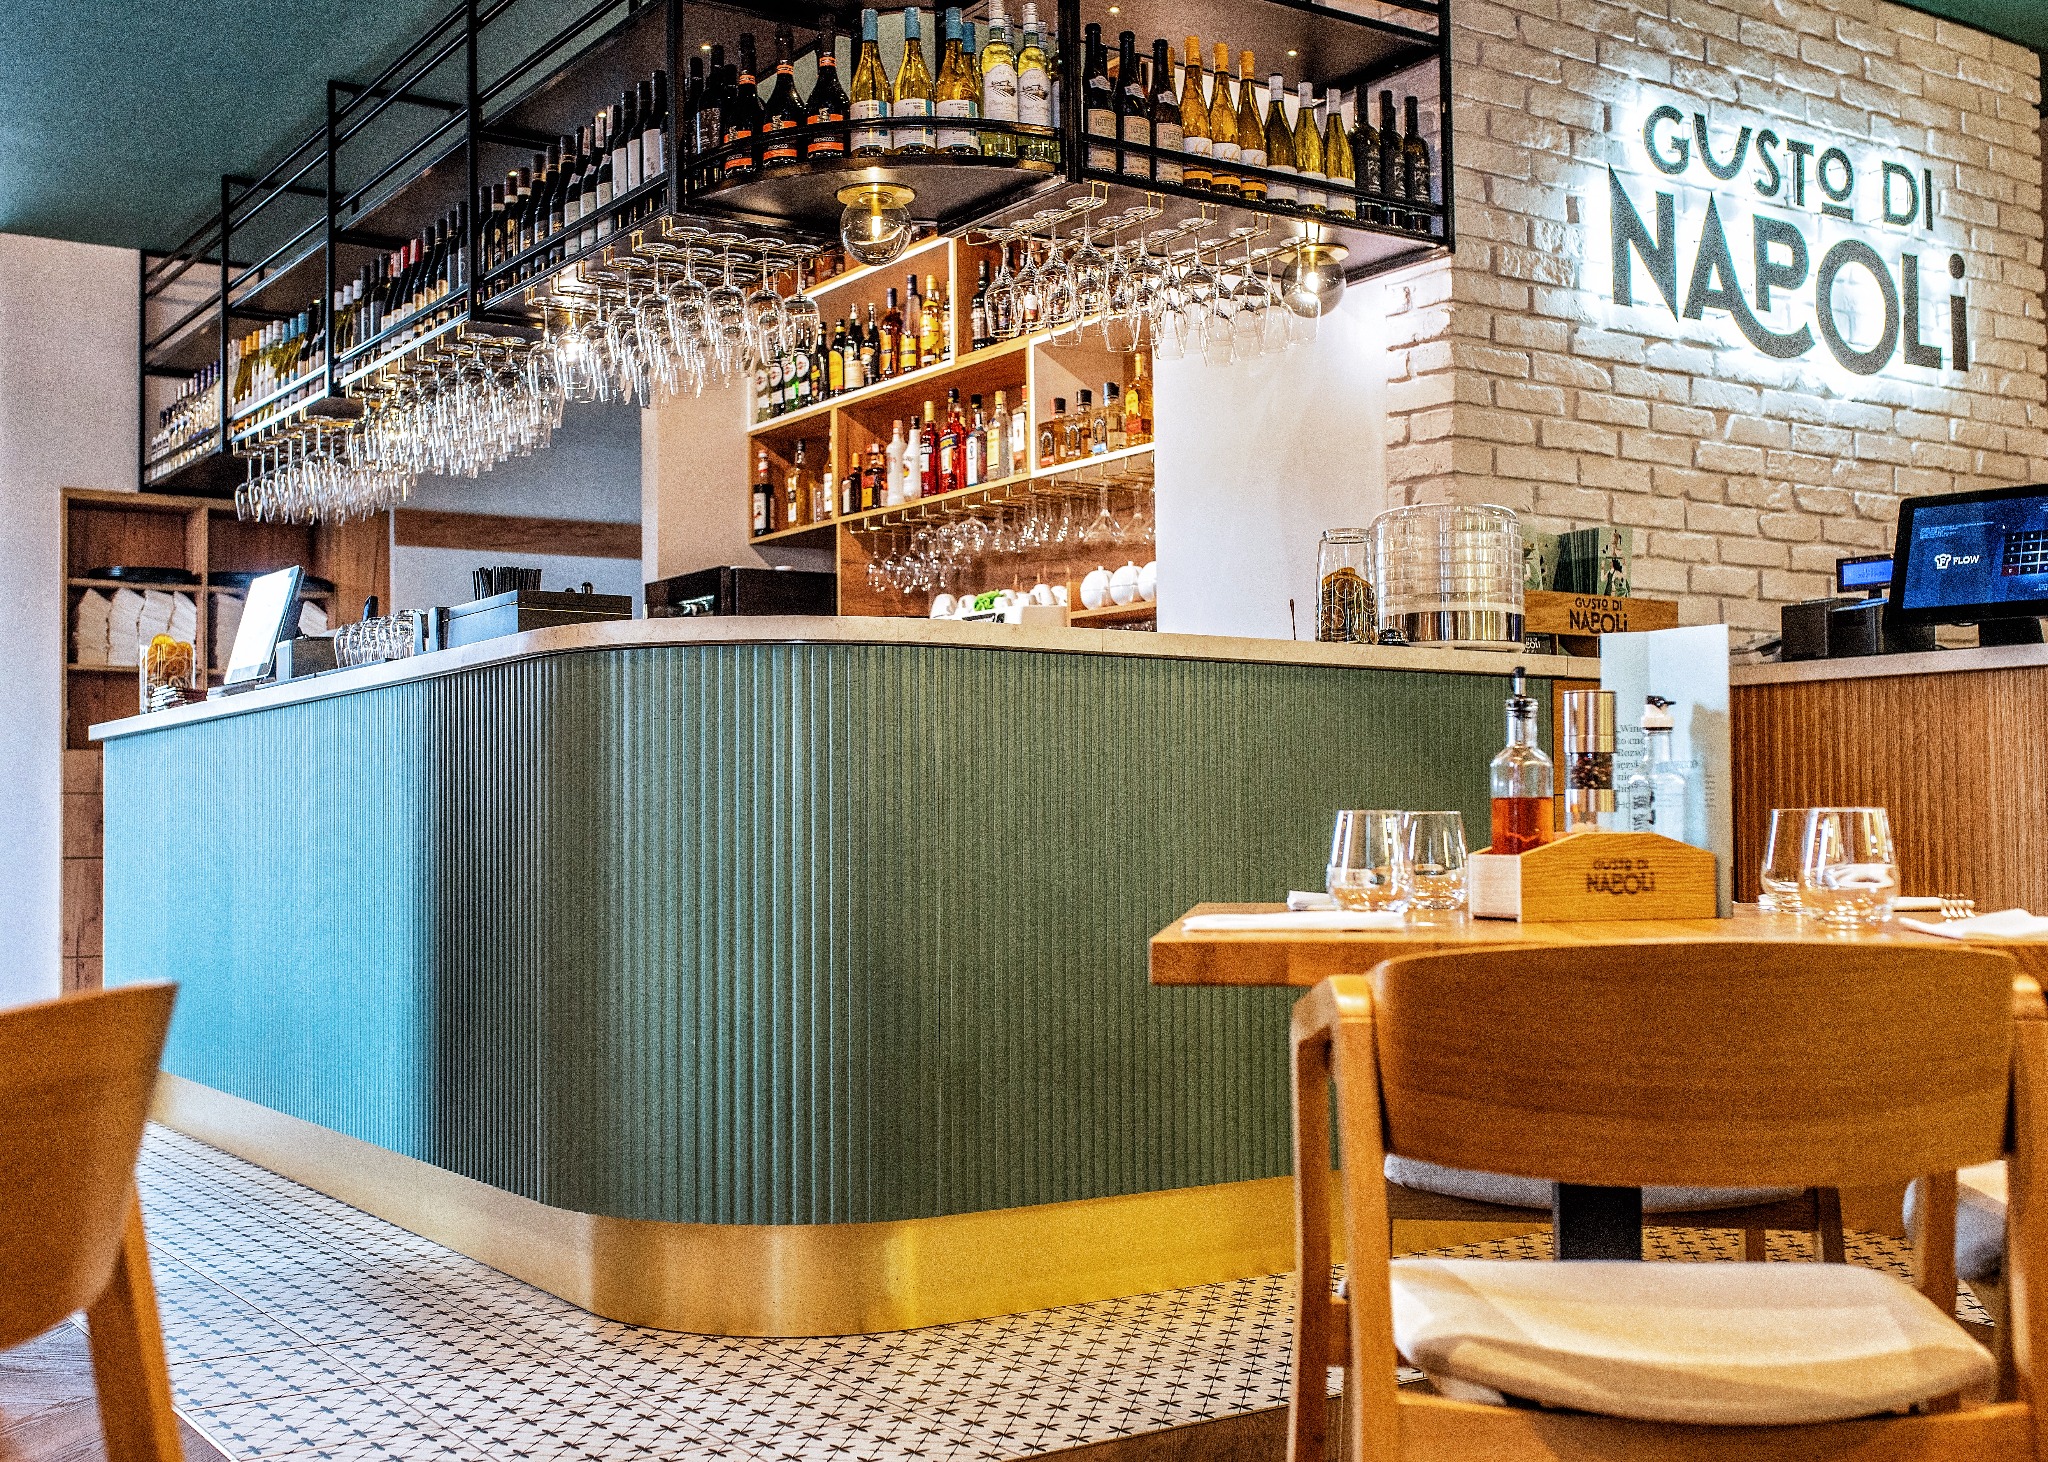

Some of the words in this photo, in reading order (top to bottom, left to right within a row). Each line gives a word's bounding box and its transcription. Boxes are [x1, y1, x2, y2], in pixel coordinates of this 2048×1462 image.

[1642, 104, 1854, 221] GUSTO
[1881, 160, 1934, 231] DI
[1953, 555, 1980, 565] FLOW
[1575, 597, 1609, 611] GUSTO
[1612, 599, 1622, 612] DI
